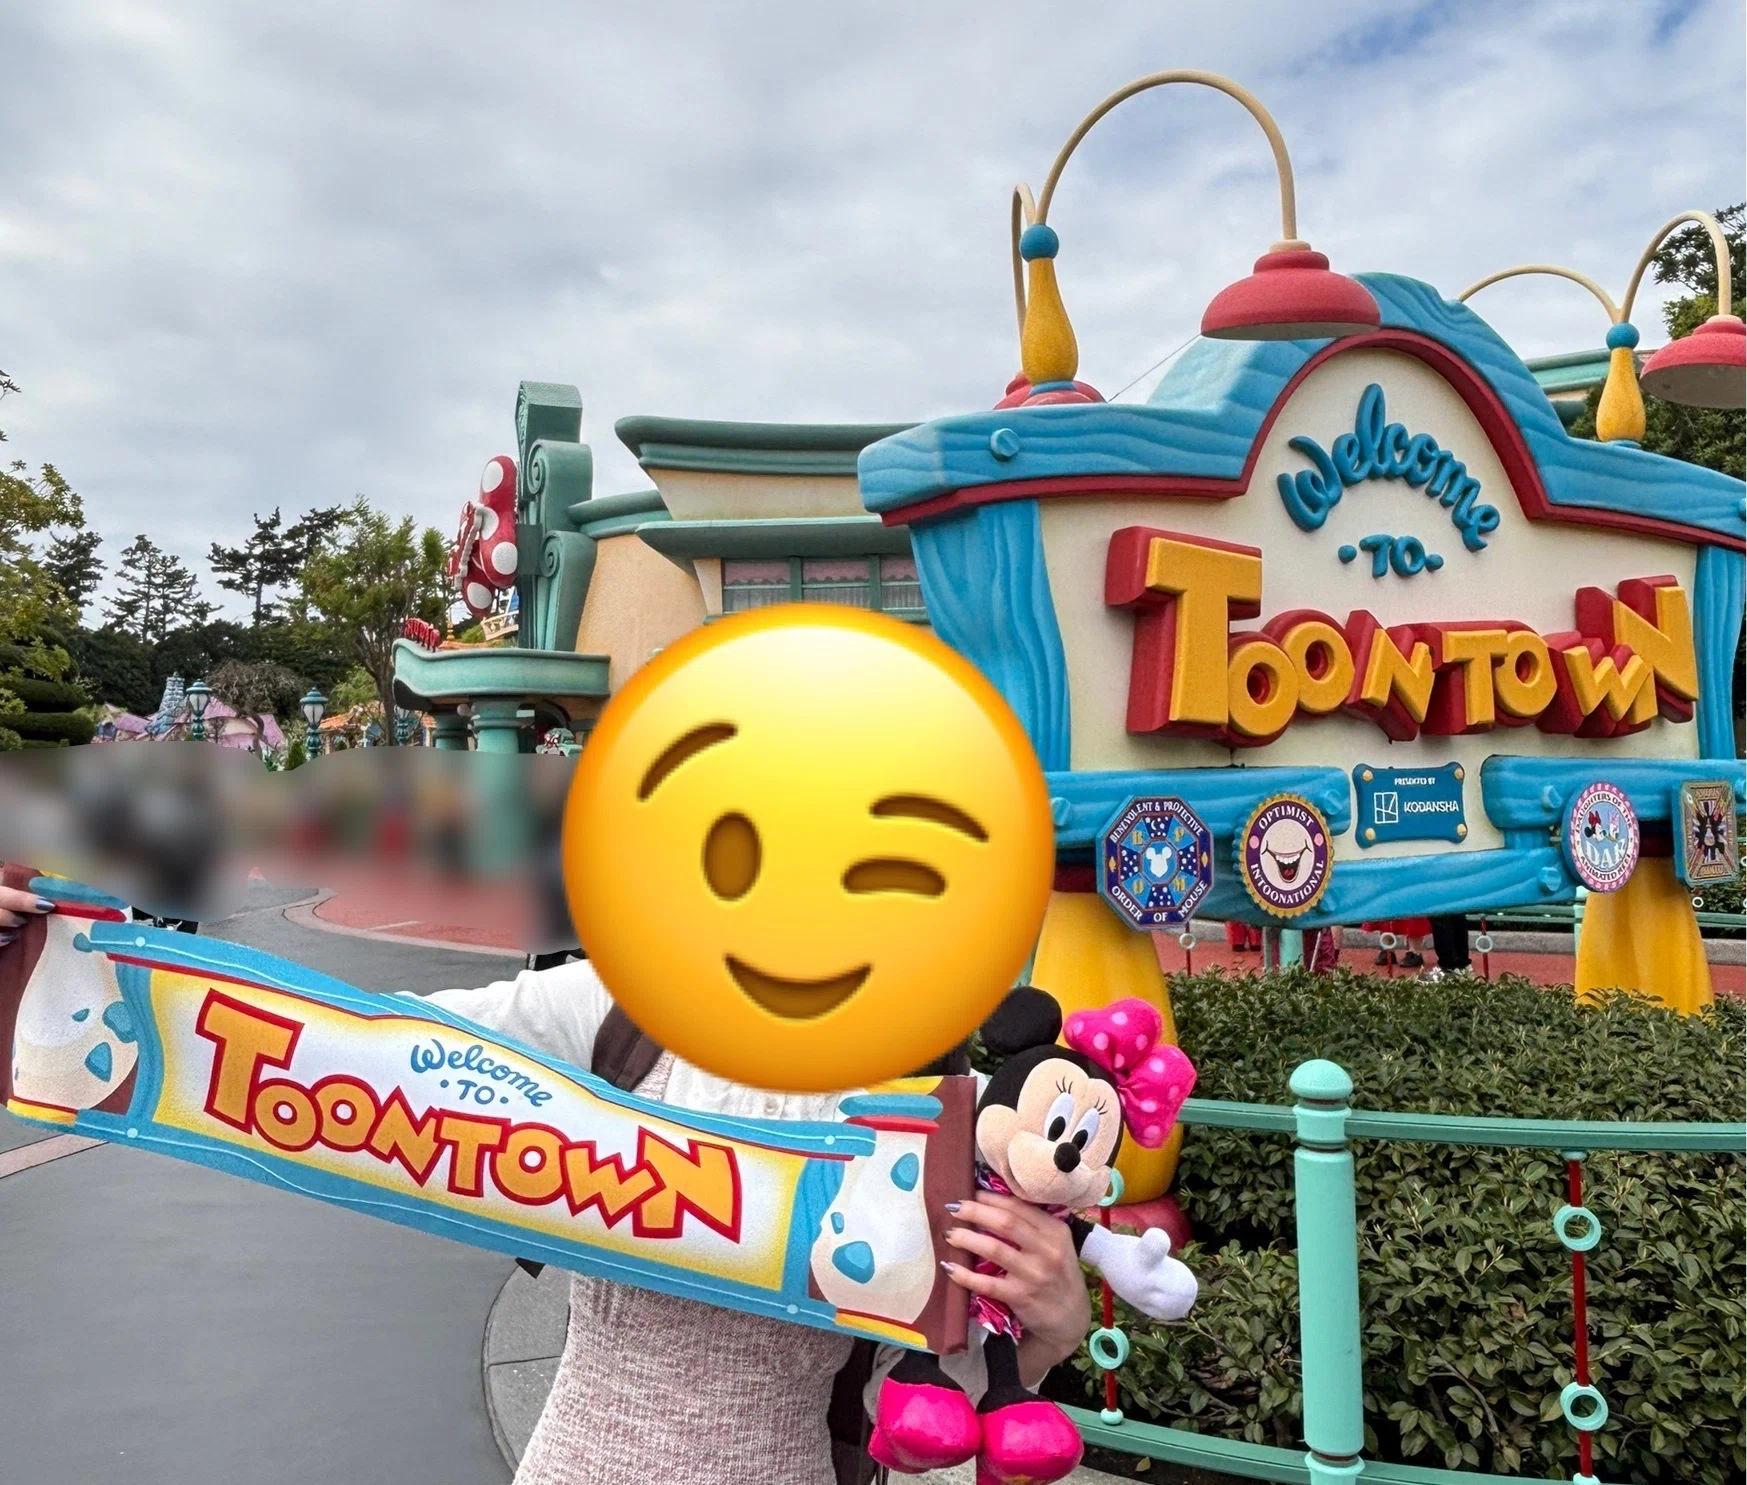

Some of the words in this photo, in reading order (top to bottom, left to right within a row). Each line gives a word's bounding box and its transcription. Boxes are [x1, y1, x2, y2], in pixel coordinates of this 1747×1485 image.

[1277, 383, 1500, 551] Welcome
[1105, 526, 1698, 748] TOONTOWN
[1109, 802, 1153, 844] BENEVOLENT
[1154, 801, 1161, 812] &
[1163, 801, 1204, 837] PROTECTIVE
[1258, 805, 1314, 830] OPTIMIST
[1404, 801, 1460, 813] KODANSHA
[1111, 885, 1143, 921] ORDER
[1153, 912, 1168, 922] OF
[1178, 880, 1207, 918] MOUSE
[1250, 860, 1324, 904] INTOONATIONAL
[411, 1038, 553, 1107] Welcome
[195, 988, 742, 1243] TOONTOWN
